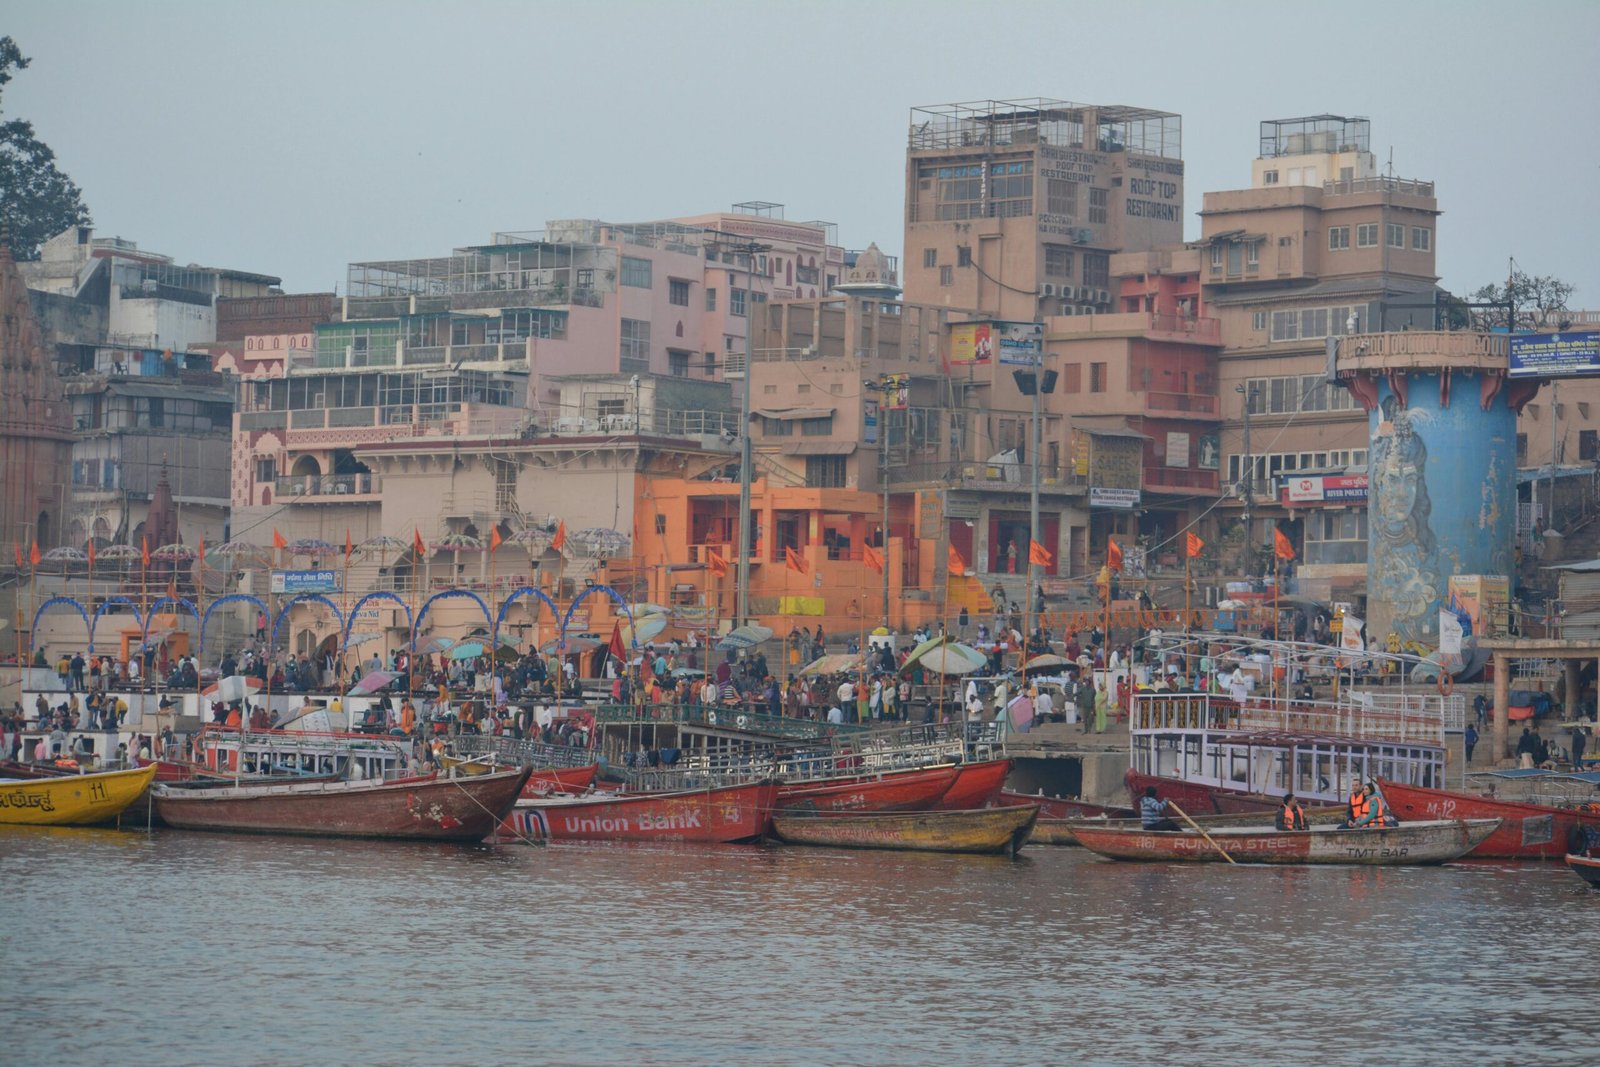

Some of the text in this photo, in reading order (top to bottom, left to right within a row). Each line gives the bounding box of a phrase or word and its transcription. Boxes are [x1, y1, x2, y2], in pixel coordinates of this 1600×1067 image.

[1130, 178, 1177, 199] ROOF TOP
[1126, 198, 1181, 223] RESTAURANT
[1345, 489, 1363, 497] POLICE
[1426, 800, 1456, 818] M-12
[566, 814, 628, 833] Union
[1246, 837, 1297, 850] STEEL
[1345, 847, 1409, 858] TMT BAR
